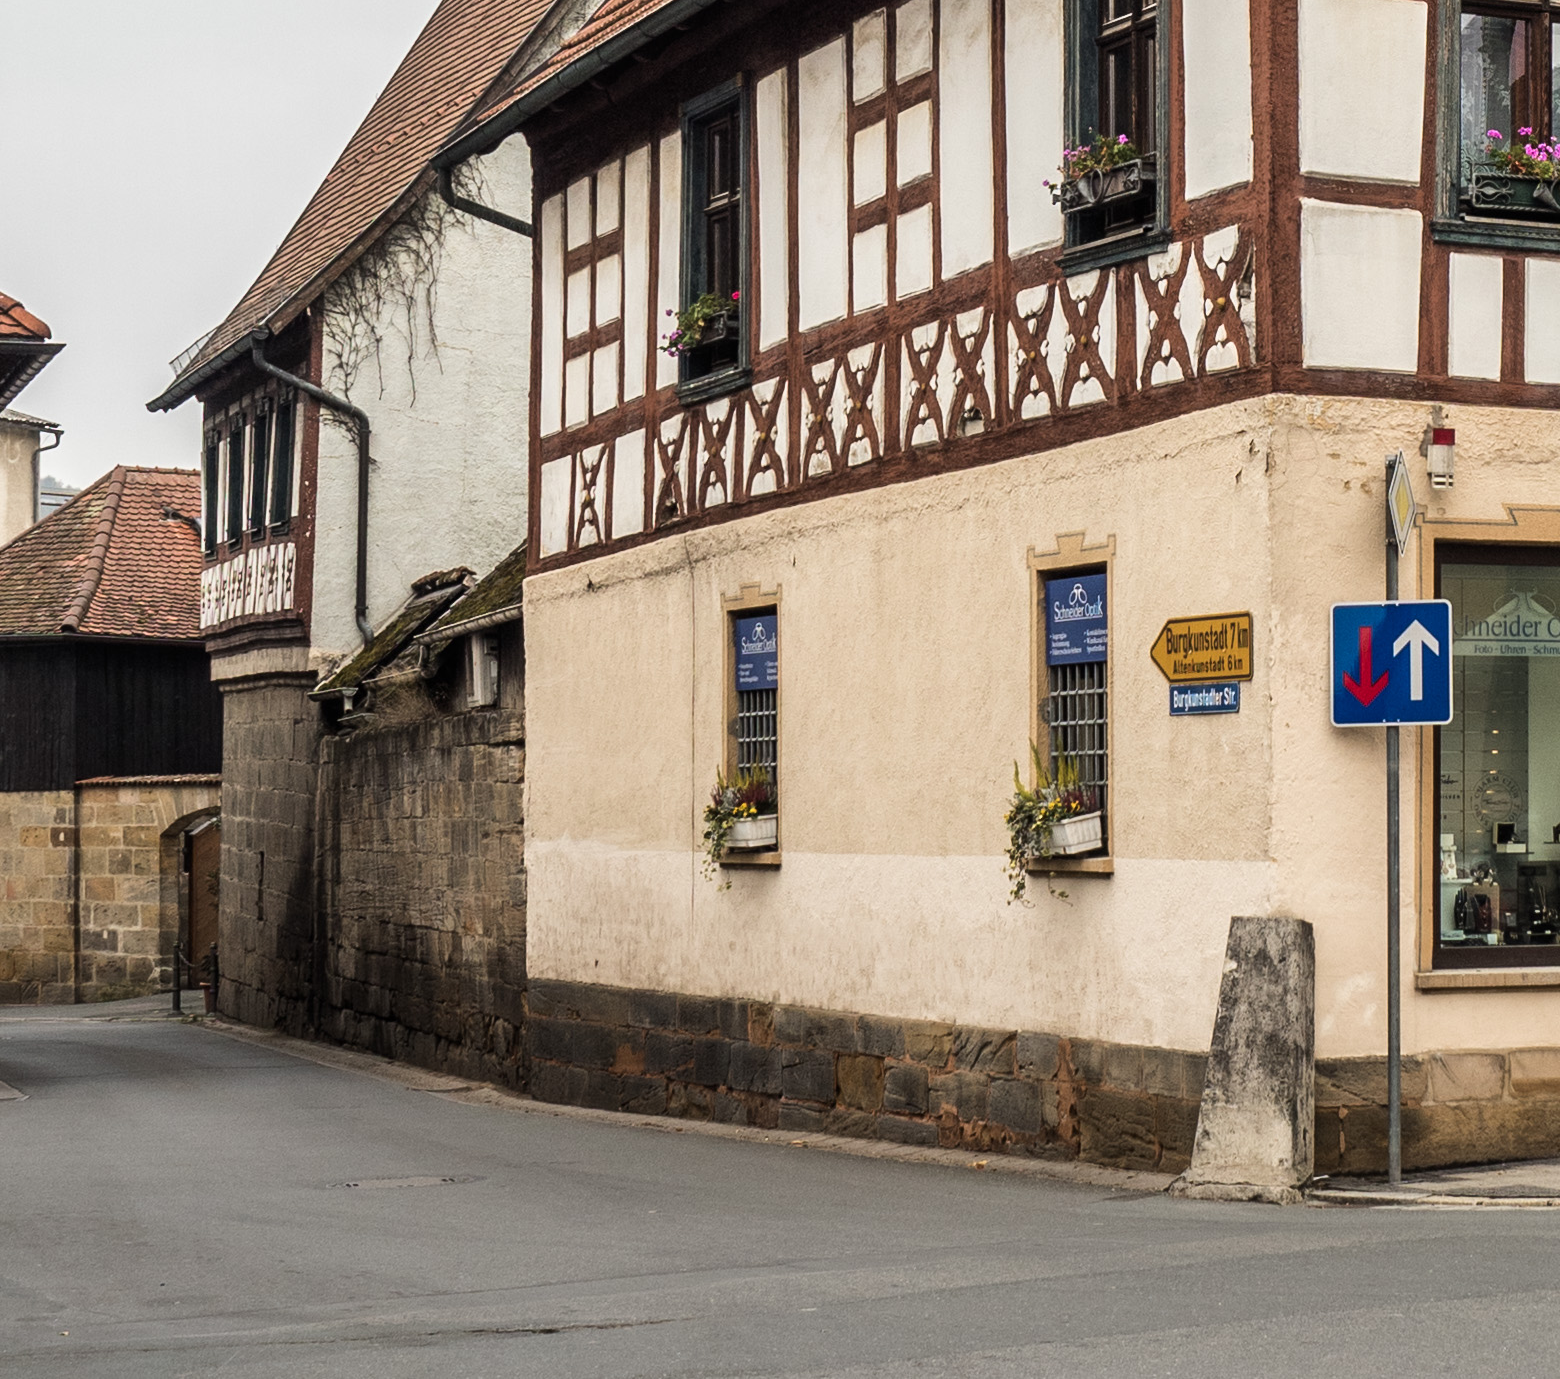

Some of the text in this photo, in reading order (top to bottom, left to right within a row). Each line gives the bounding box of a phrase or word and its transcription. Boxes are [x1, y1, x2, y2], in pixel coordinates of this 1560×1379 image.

[1054, 595, 1103, 620] Schneider Optik
[1453, 614, 1542, 638] chneider
[1166, 622, 1249, 659] Burgkunstadt 7 km
[1474, 644, 1493, 654] Foto
[1500, 645, 1526, 655] Uhren
[1173, 654, 1243, 675] Altenkunstadt 6 km
[1223, 687, 1237, 706] Str.
